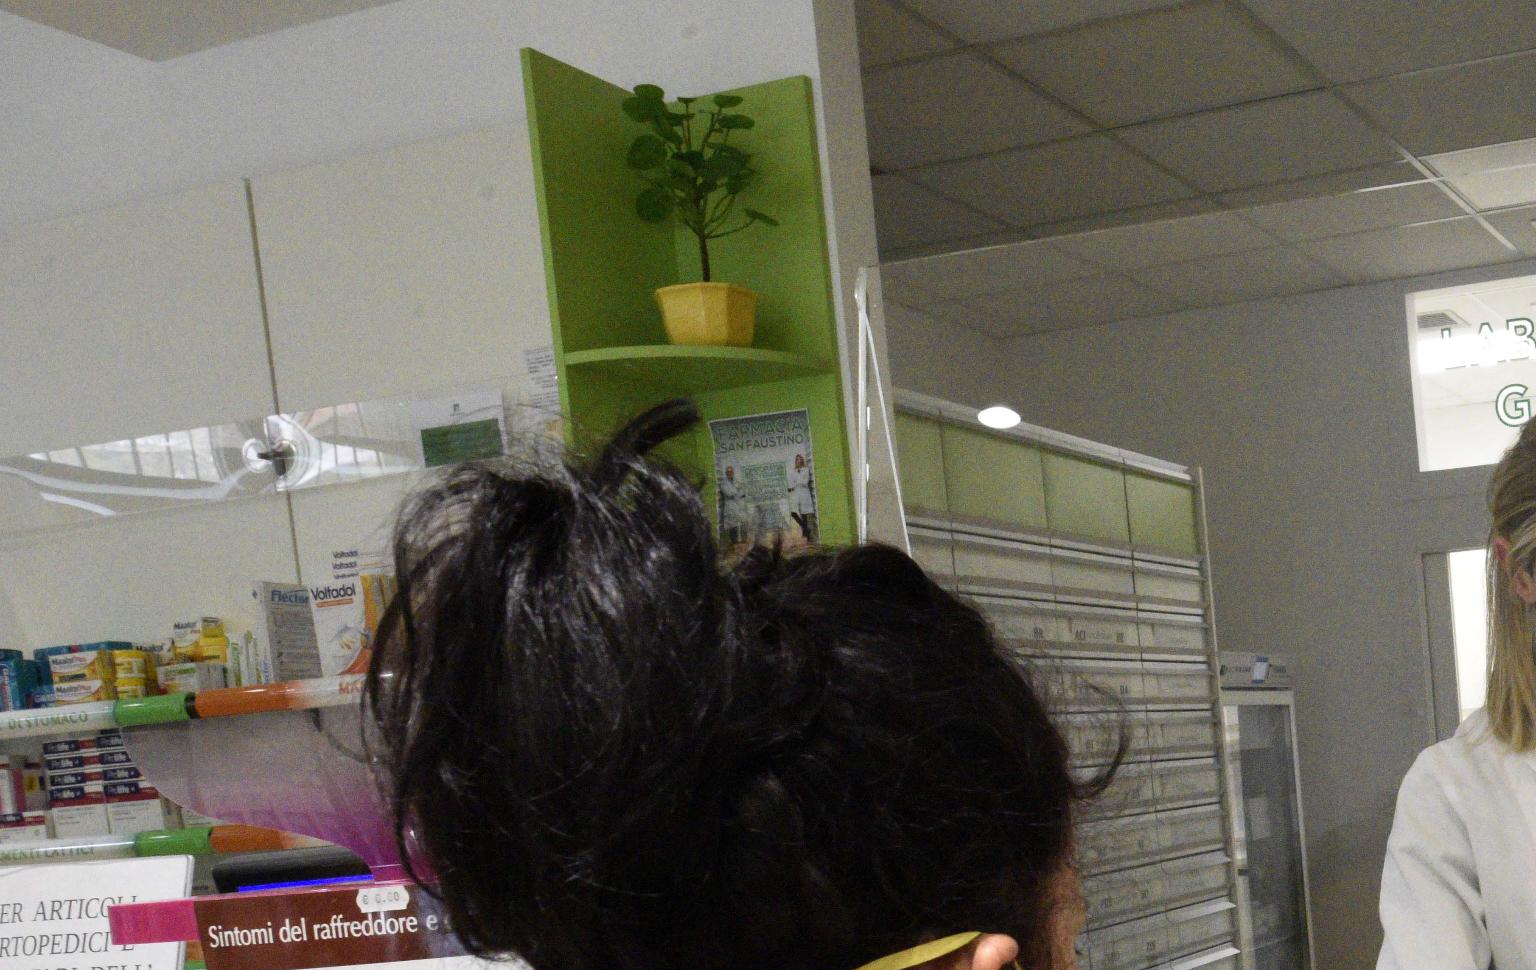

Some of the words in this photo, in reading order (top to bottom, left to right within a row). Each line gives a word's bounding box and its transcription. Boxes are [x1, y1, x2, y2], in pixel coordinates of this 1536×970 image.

[311, 583, 357, 601] Voltadol
[32, 896, 138, 922] ARTICO
[208, 921, 273, 949] Sintomi
[279, 917, 307, 944] del
[314, 911, 418, 941] raffreddore
[426, 914, 438, 931] e
